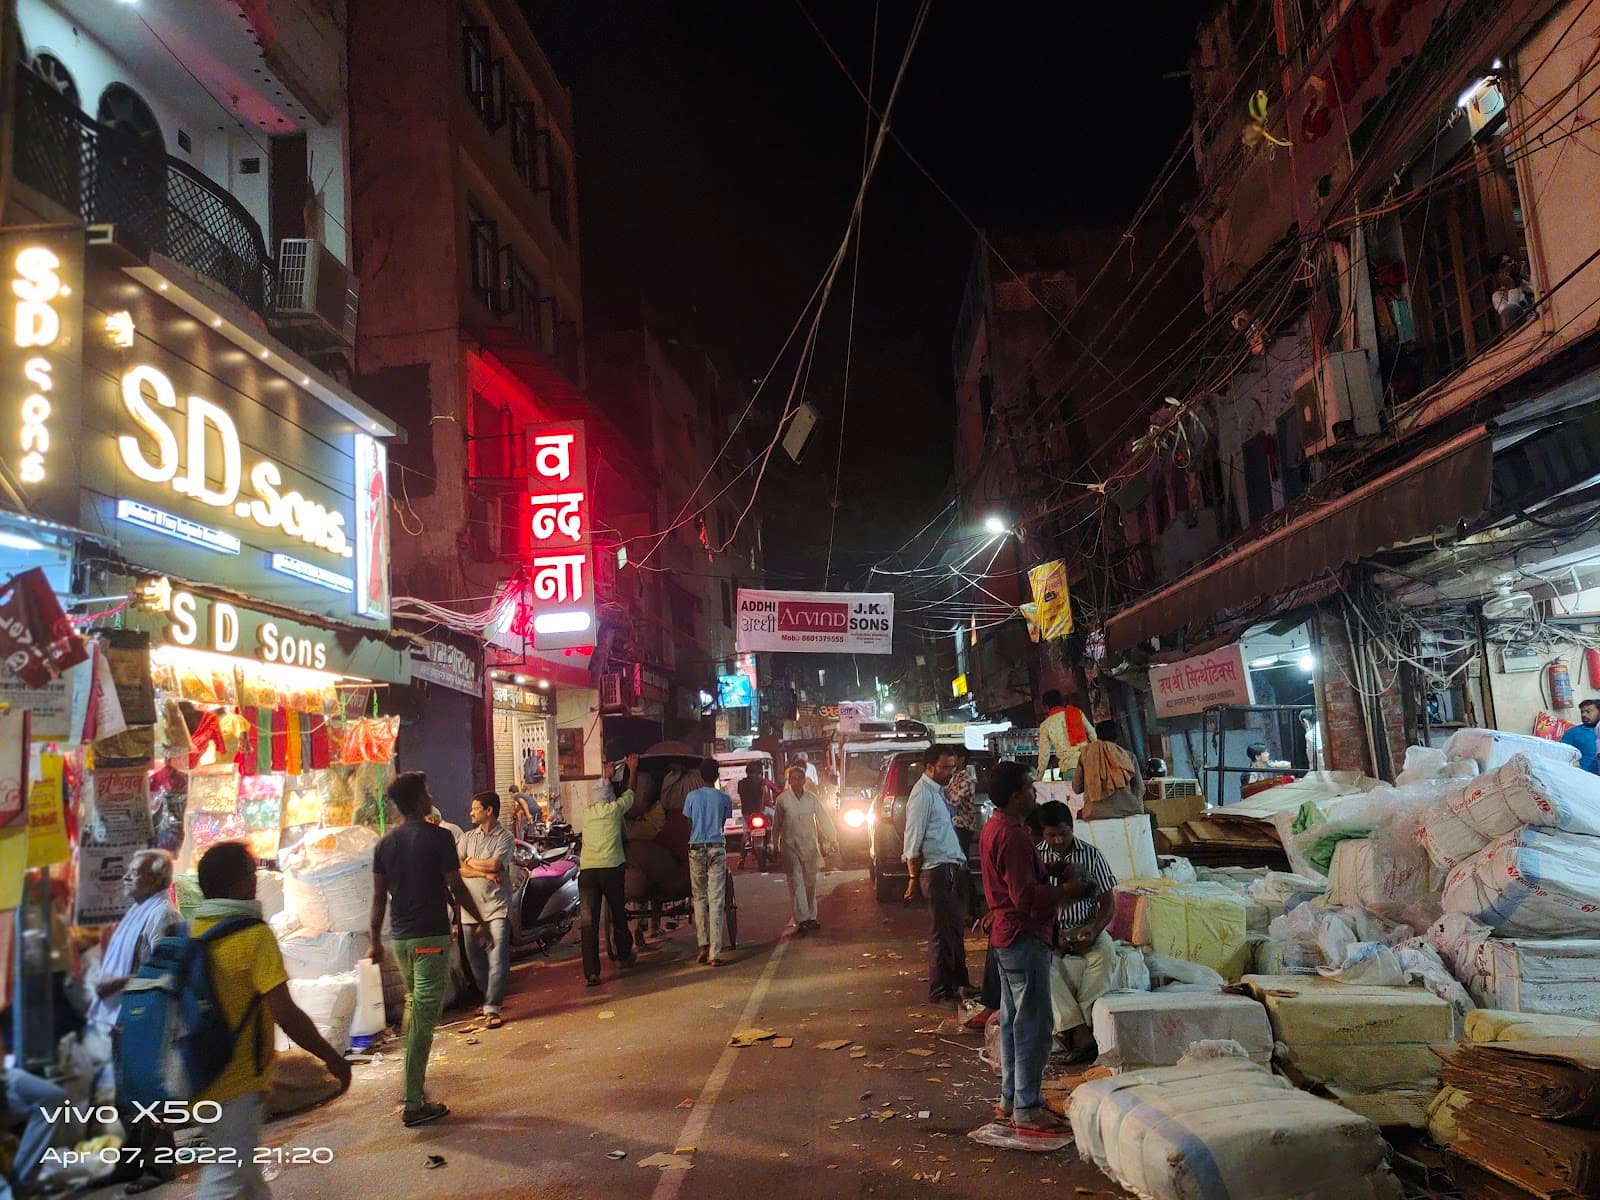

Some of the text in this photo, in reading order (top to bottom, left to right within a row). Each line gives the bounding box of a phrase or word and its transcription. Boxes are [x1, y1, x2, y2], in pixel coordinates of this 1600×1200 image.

[741, 600, 776, 612] ADDHI
[853, 603, 885, 614] J.K.
[171, 591, 327, 670] S D Sons
[849, 618, 889, 631] SONS
